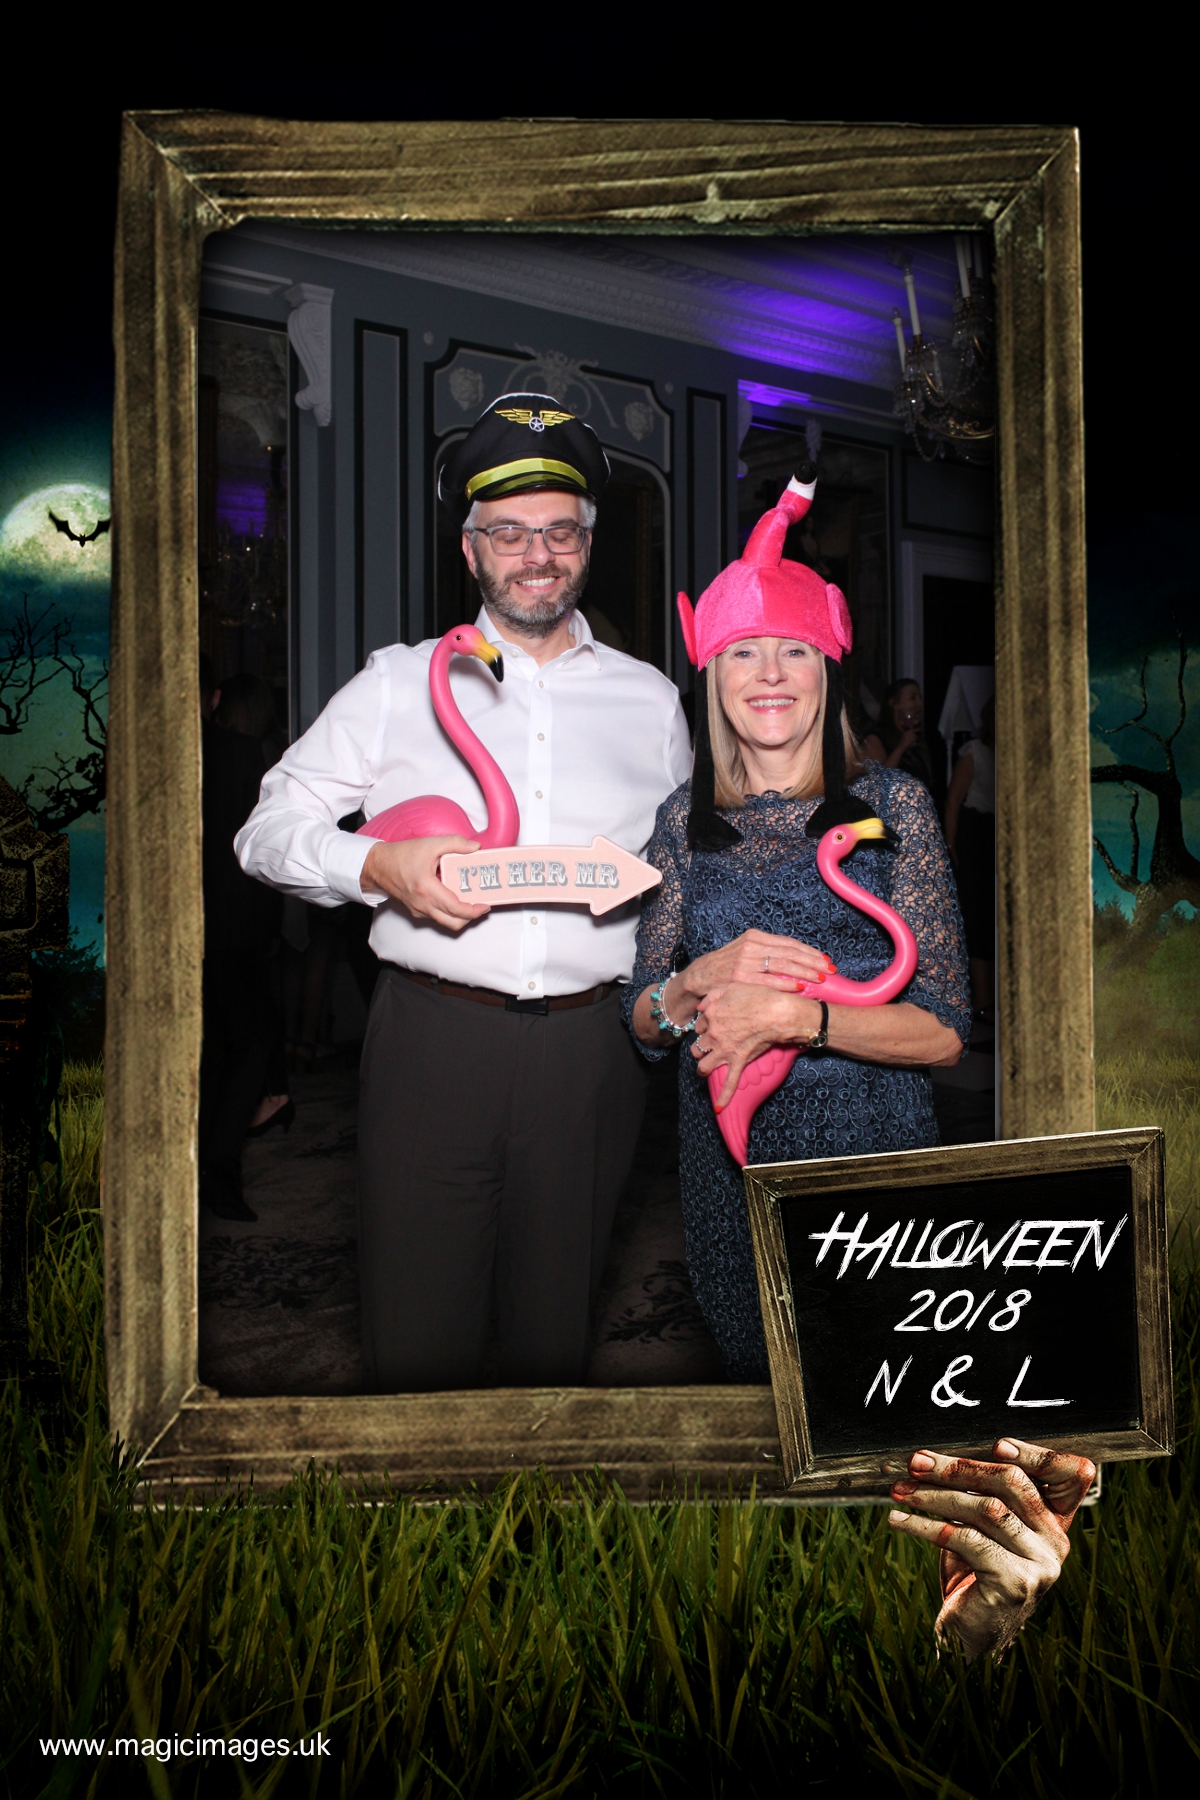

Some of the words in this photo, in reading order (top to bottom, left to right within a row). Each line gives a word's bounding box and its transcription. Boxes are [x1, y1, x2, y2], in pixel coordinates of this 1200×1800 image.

[457, 863, 501, 893] I'M
[505, 860, 568, 888] HER
[574, 861, 620, 888] MR
